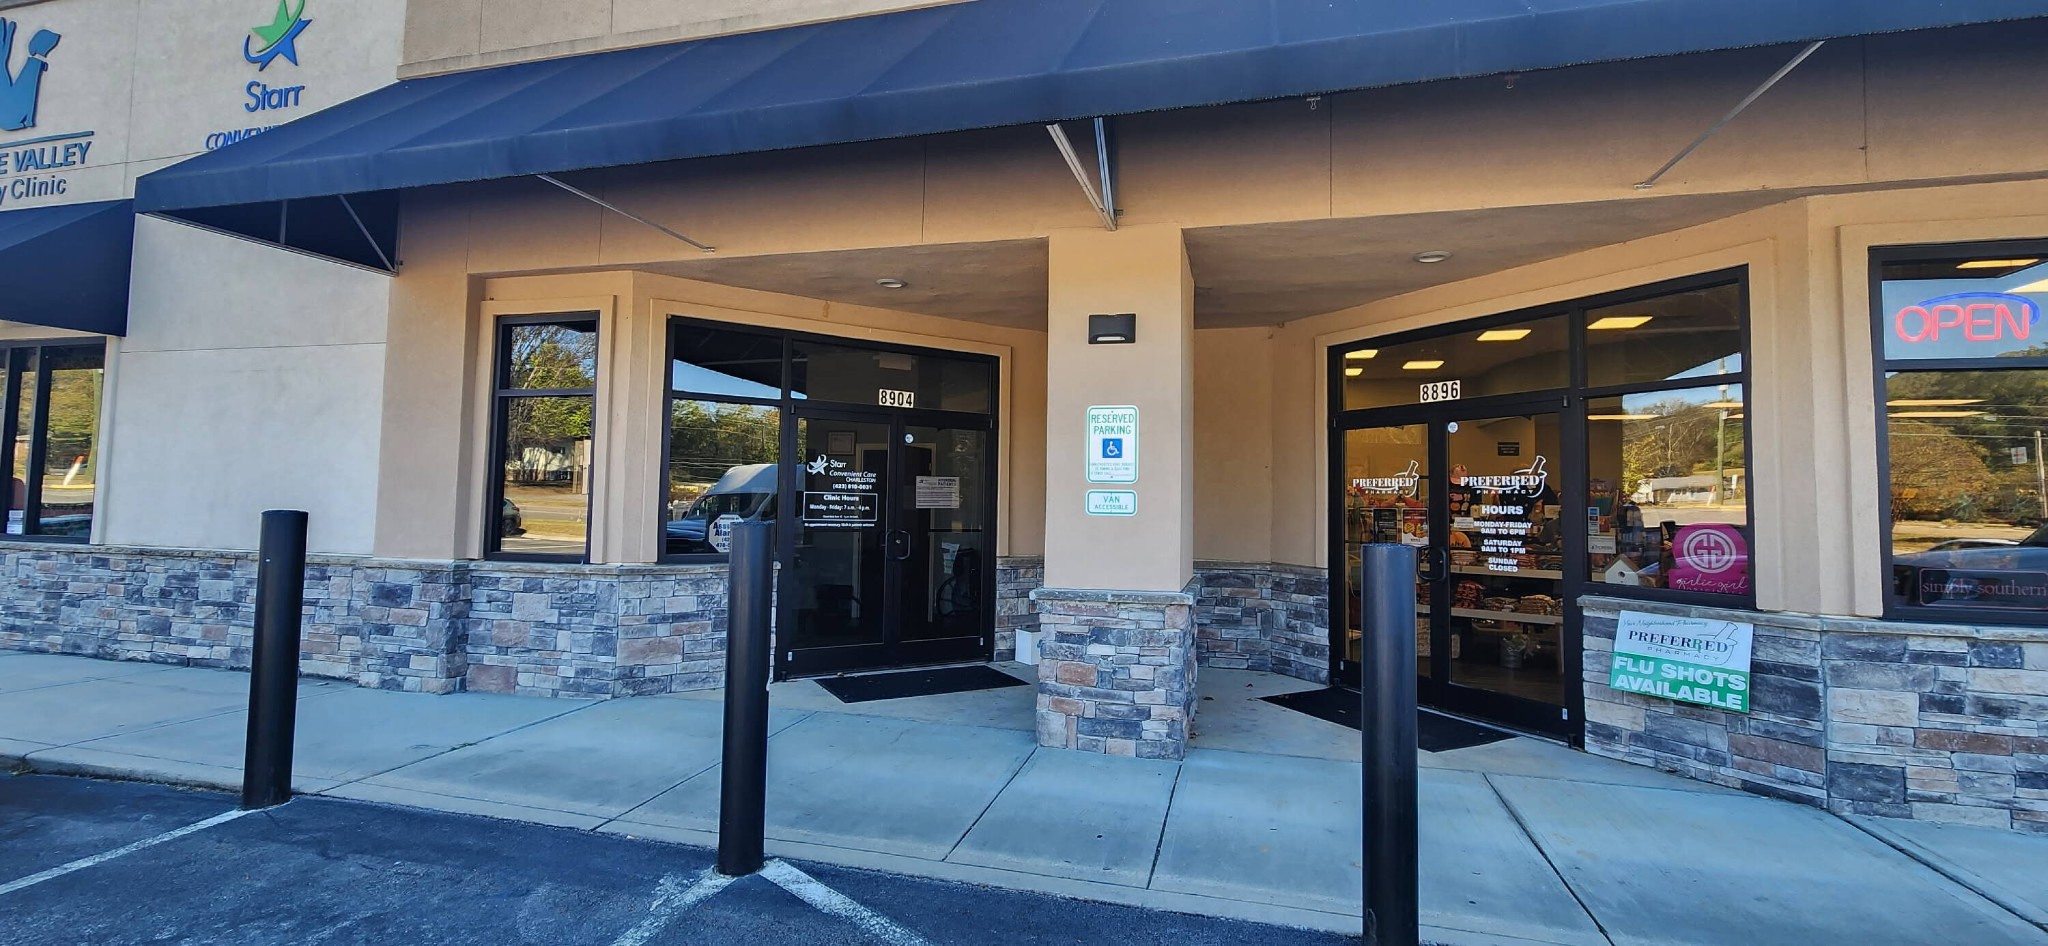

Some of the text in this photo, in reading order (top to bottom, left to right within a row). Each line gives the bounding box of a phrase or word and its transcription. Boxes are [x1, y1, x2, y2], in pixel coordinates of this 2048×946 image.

[244, 80, 306, 112] Starr
[14, 141, 92, 172] VALLEY
[11, 175, 66, 199] Clinic
[1896, 304, 2030, 342] OPEN
[880, 390, 912, 406] 8904
[1422, 382, 1459, 401] 8896
[1091, 414, 1134, 424] RESERVED
[1093, 426, 1132, 435] PARKING
[830, 459, 847, 468] Starr
[1352, 477, 1414, 489] PREFERRED
[1460, 475, 1540, 488] PREFERRED
[1481, 505, 1524, 515] HOURS
[1978, 580, 2047, 596] southern
[1628, 630, 1728, 652] PREFERRED
[1648, 647, 1719, 660] PHARMACY
[1615, 656, 1746, 691] FLU SHOTS
[1615, 675, 1742, 709] AVAILABLE
